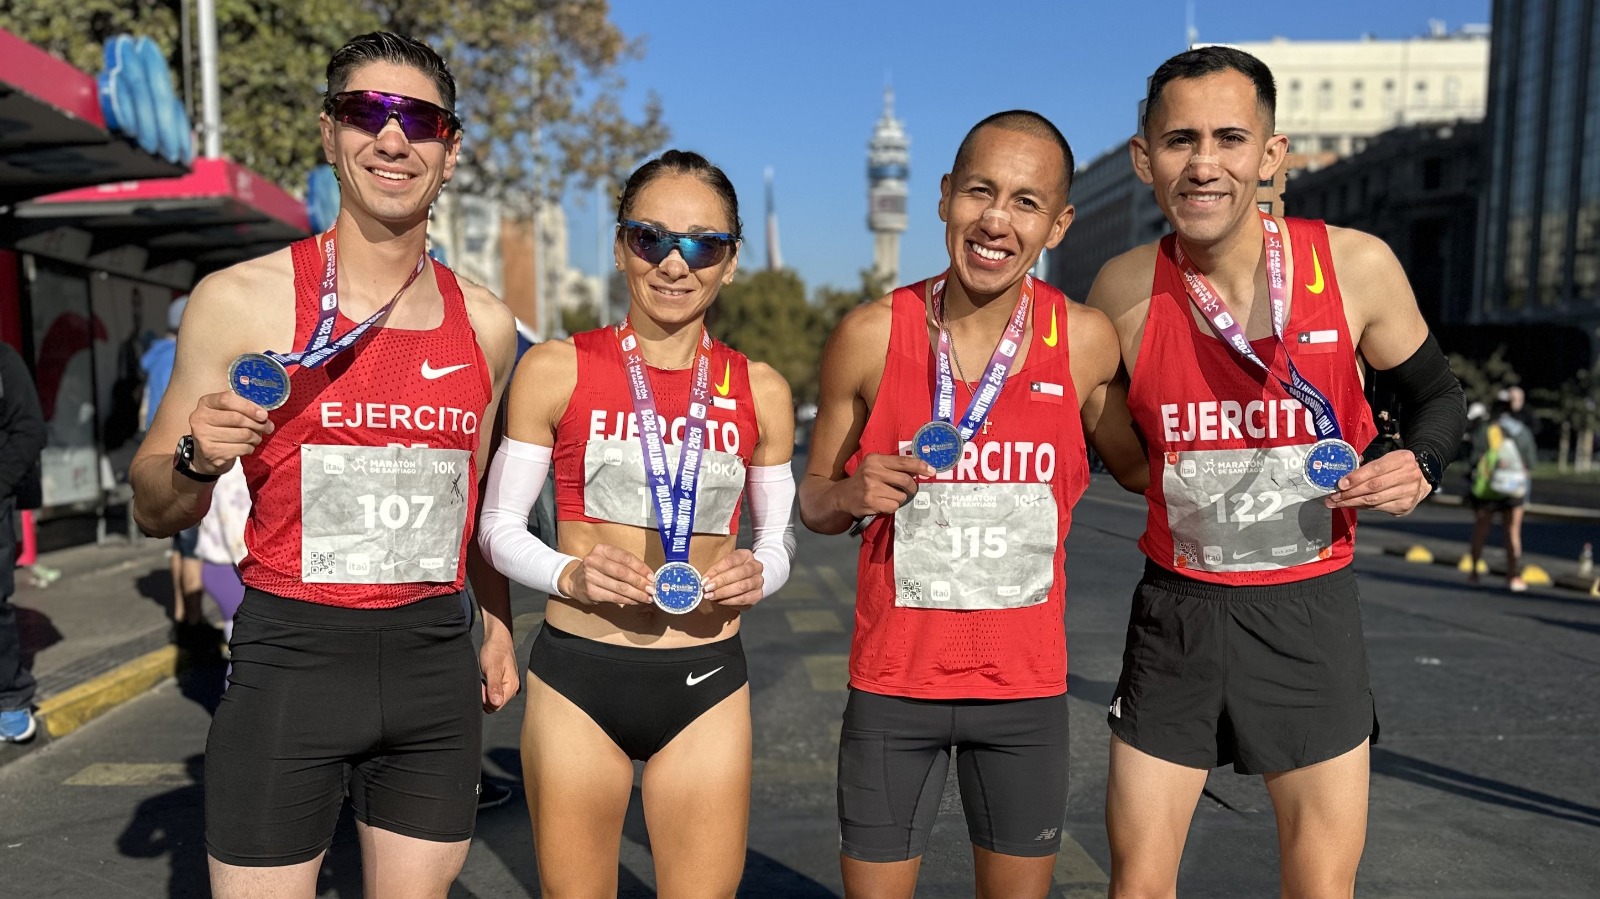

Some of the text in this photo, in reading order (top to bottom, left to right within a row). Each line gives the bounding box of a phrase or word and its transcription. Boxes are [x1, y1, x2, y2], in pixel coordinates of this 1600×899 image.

[634, 365, 649, 399] MARATÓN
[938, 375, 953, 418] SANTIAGO
[969, 384, 998, 423] SANTIAGO
[321, 402, 477, 434] EJERCITO
[640, 409, 658, 431] 2026
[688, 427, 702, 449] 2026
[645, 433, 666, 476] SANTIAGO
[1218, 459, 1263, 469] MARATÓN
[325, 461, 343, 472] itaú
[370, 459, 456, 474] MARATÓN 10K
[681, 450, 699, 491] SANTIAGO
[706, 461, 730, 477] 10K
[952, 494, 1040, 507] MARATÓN 10K
[1210, 491, 1284, 524] 122
[356, 494, 434, 530] 107
[946, 527, 1008, 559] 115
[349, 560, 368, 571] itaú
[1205, 550, 1221, 562] itaú
[933, 588, 949, 597] itaú
